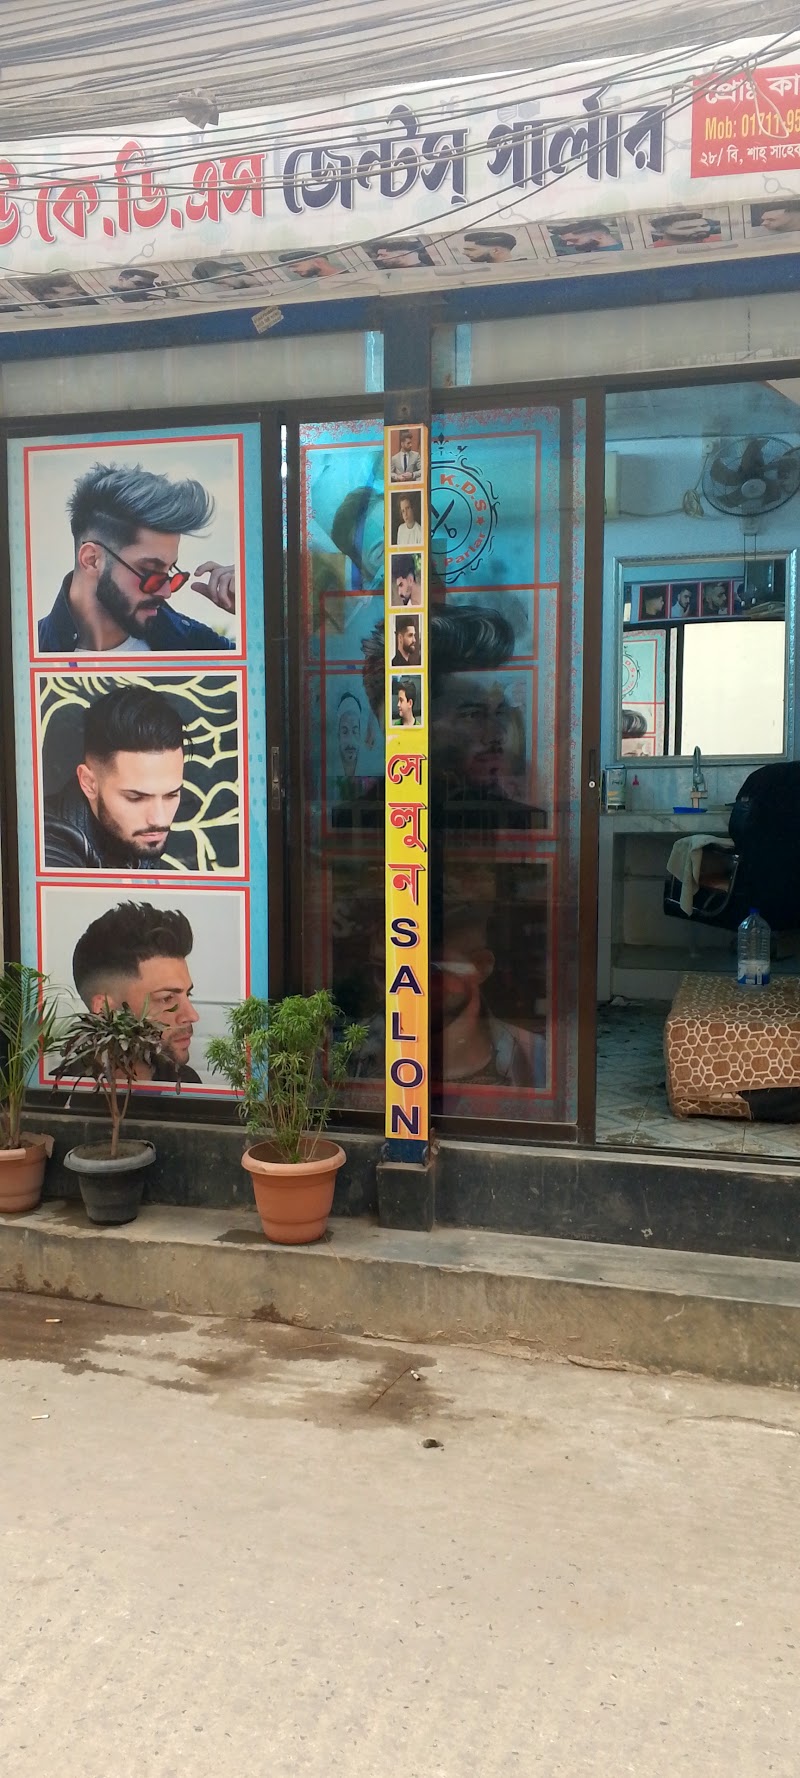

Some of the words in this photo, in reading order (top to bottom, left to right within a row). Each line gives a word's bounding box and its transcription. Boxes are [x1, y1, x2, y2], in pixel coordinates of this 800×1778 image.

[486, 84, 667, 190] পার্লার
[700, 148, 723, 167] ২৮/
[705, 115, 737, 141] Mob:
[389, 917, 425, 1135] SALON
